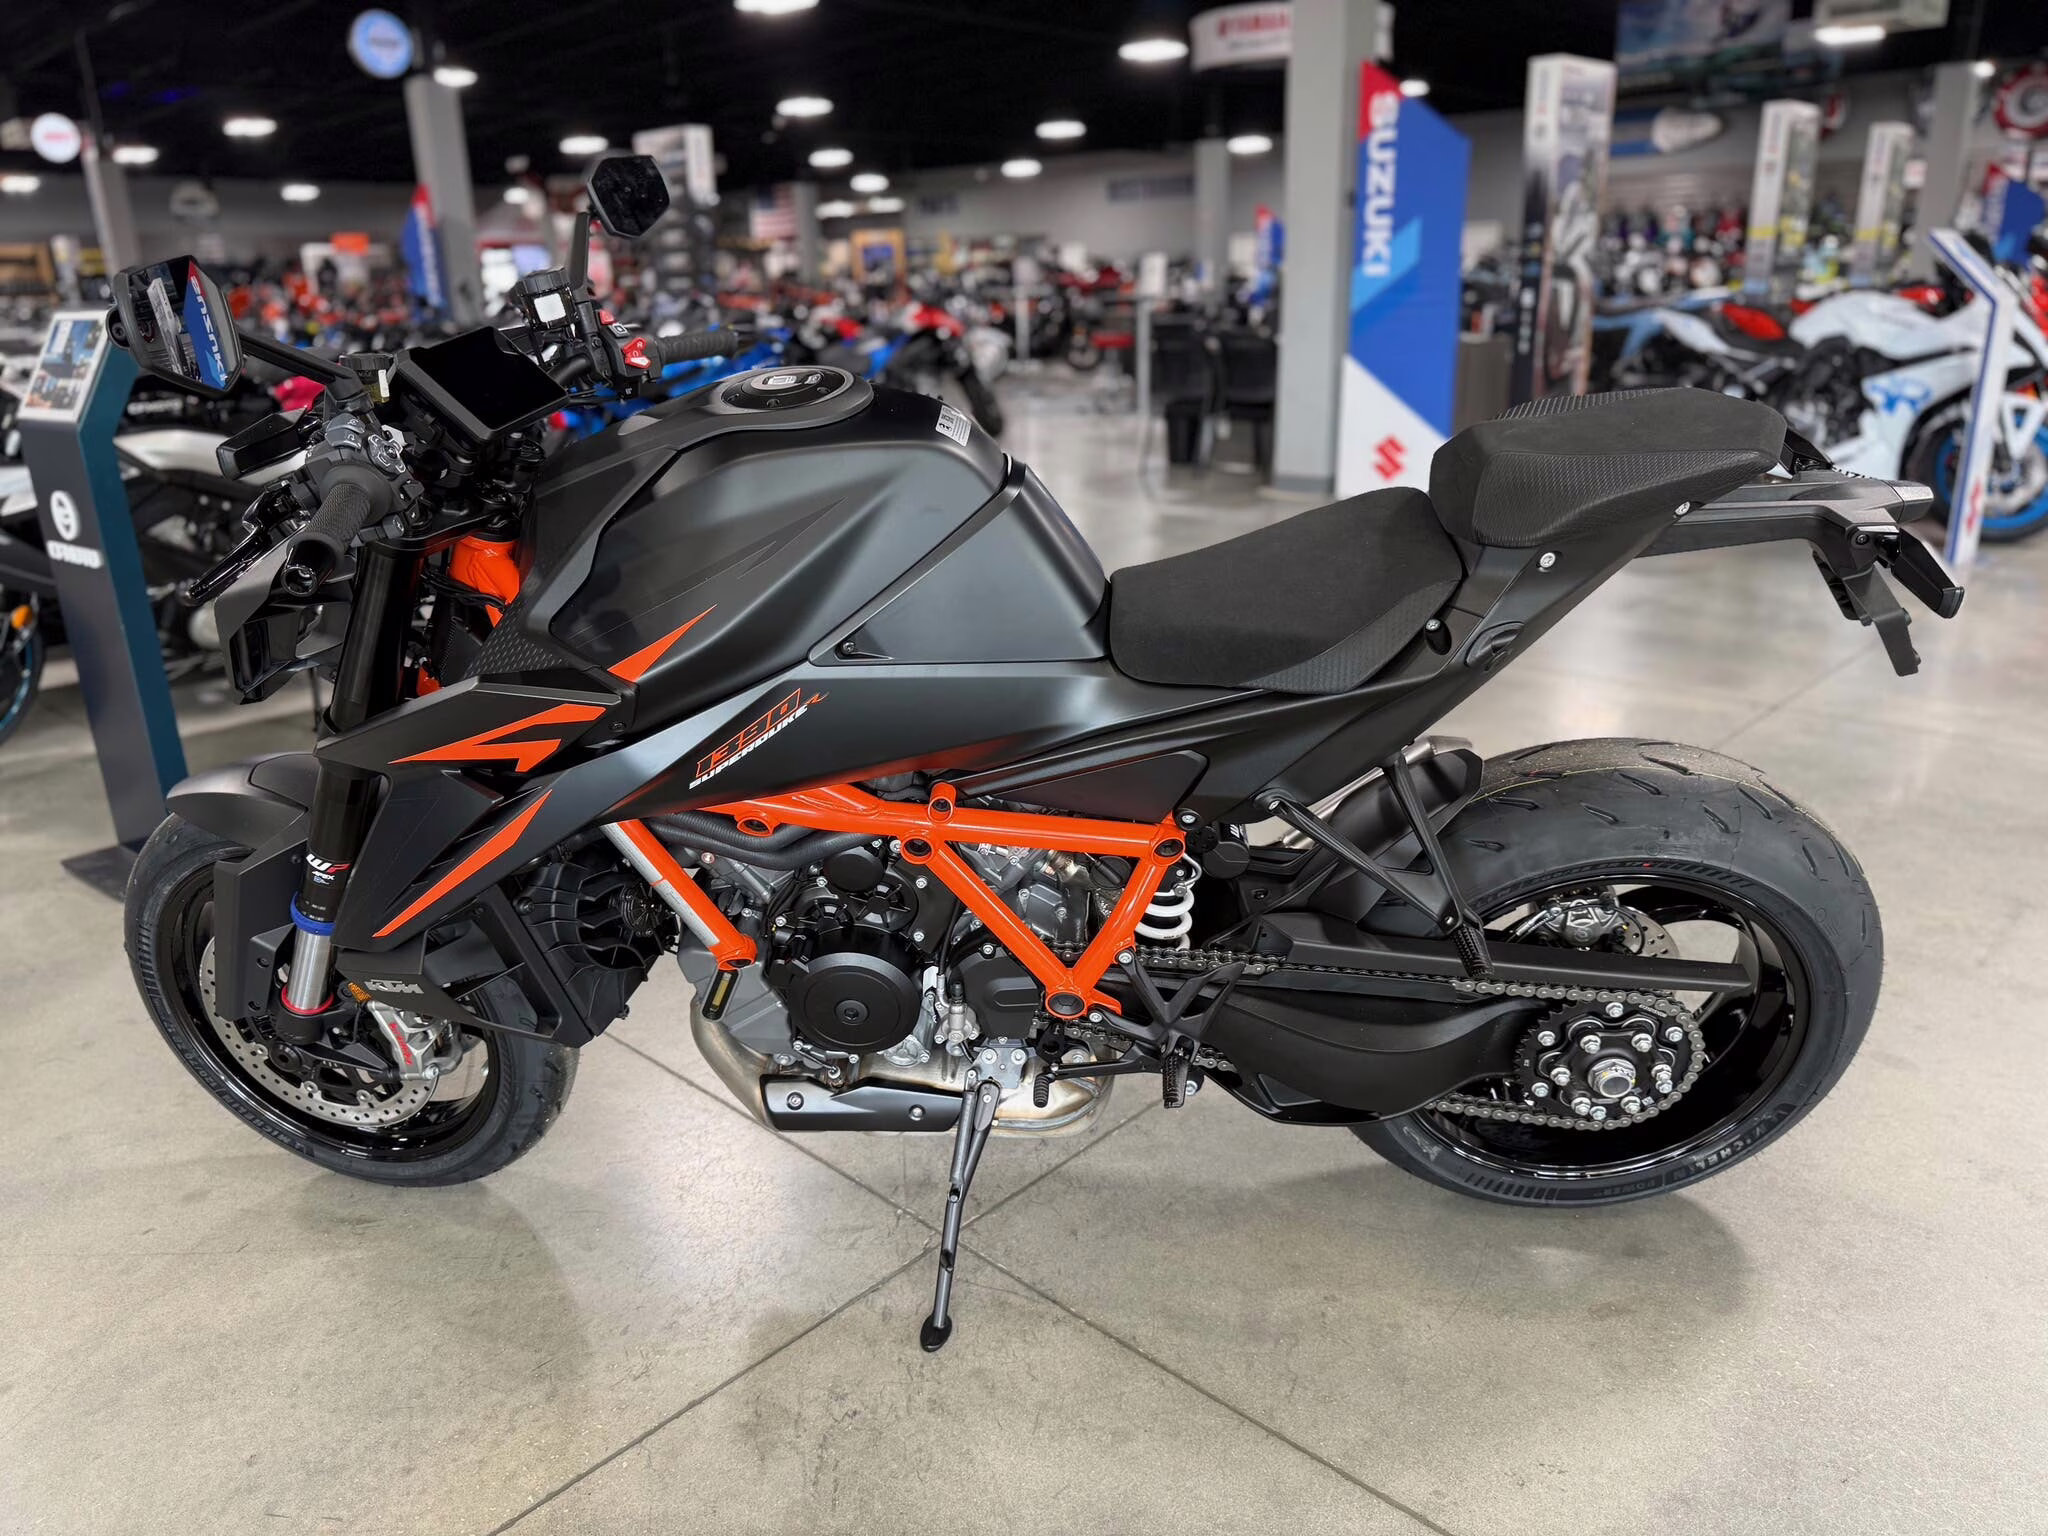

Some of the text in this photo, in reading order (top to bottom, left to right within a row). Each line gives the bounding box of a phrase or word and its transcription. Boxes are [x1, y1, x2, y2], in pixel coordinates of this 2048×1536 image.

[1362, 90, 1400, 277] SUZUKI
[364, 979, 425, 995] KTM
[223, 1095, 292, 1144] MICHELIN
